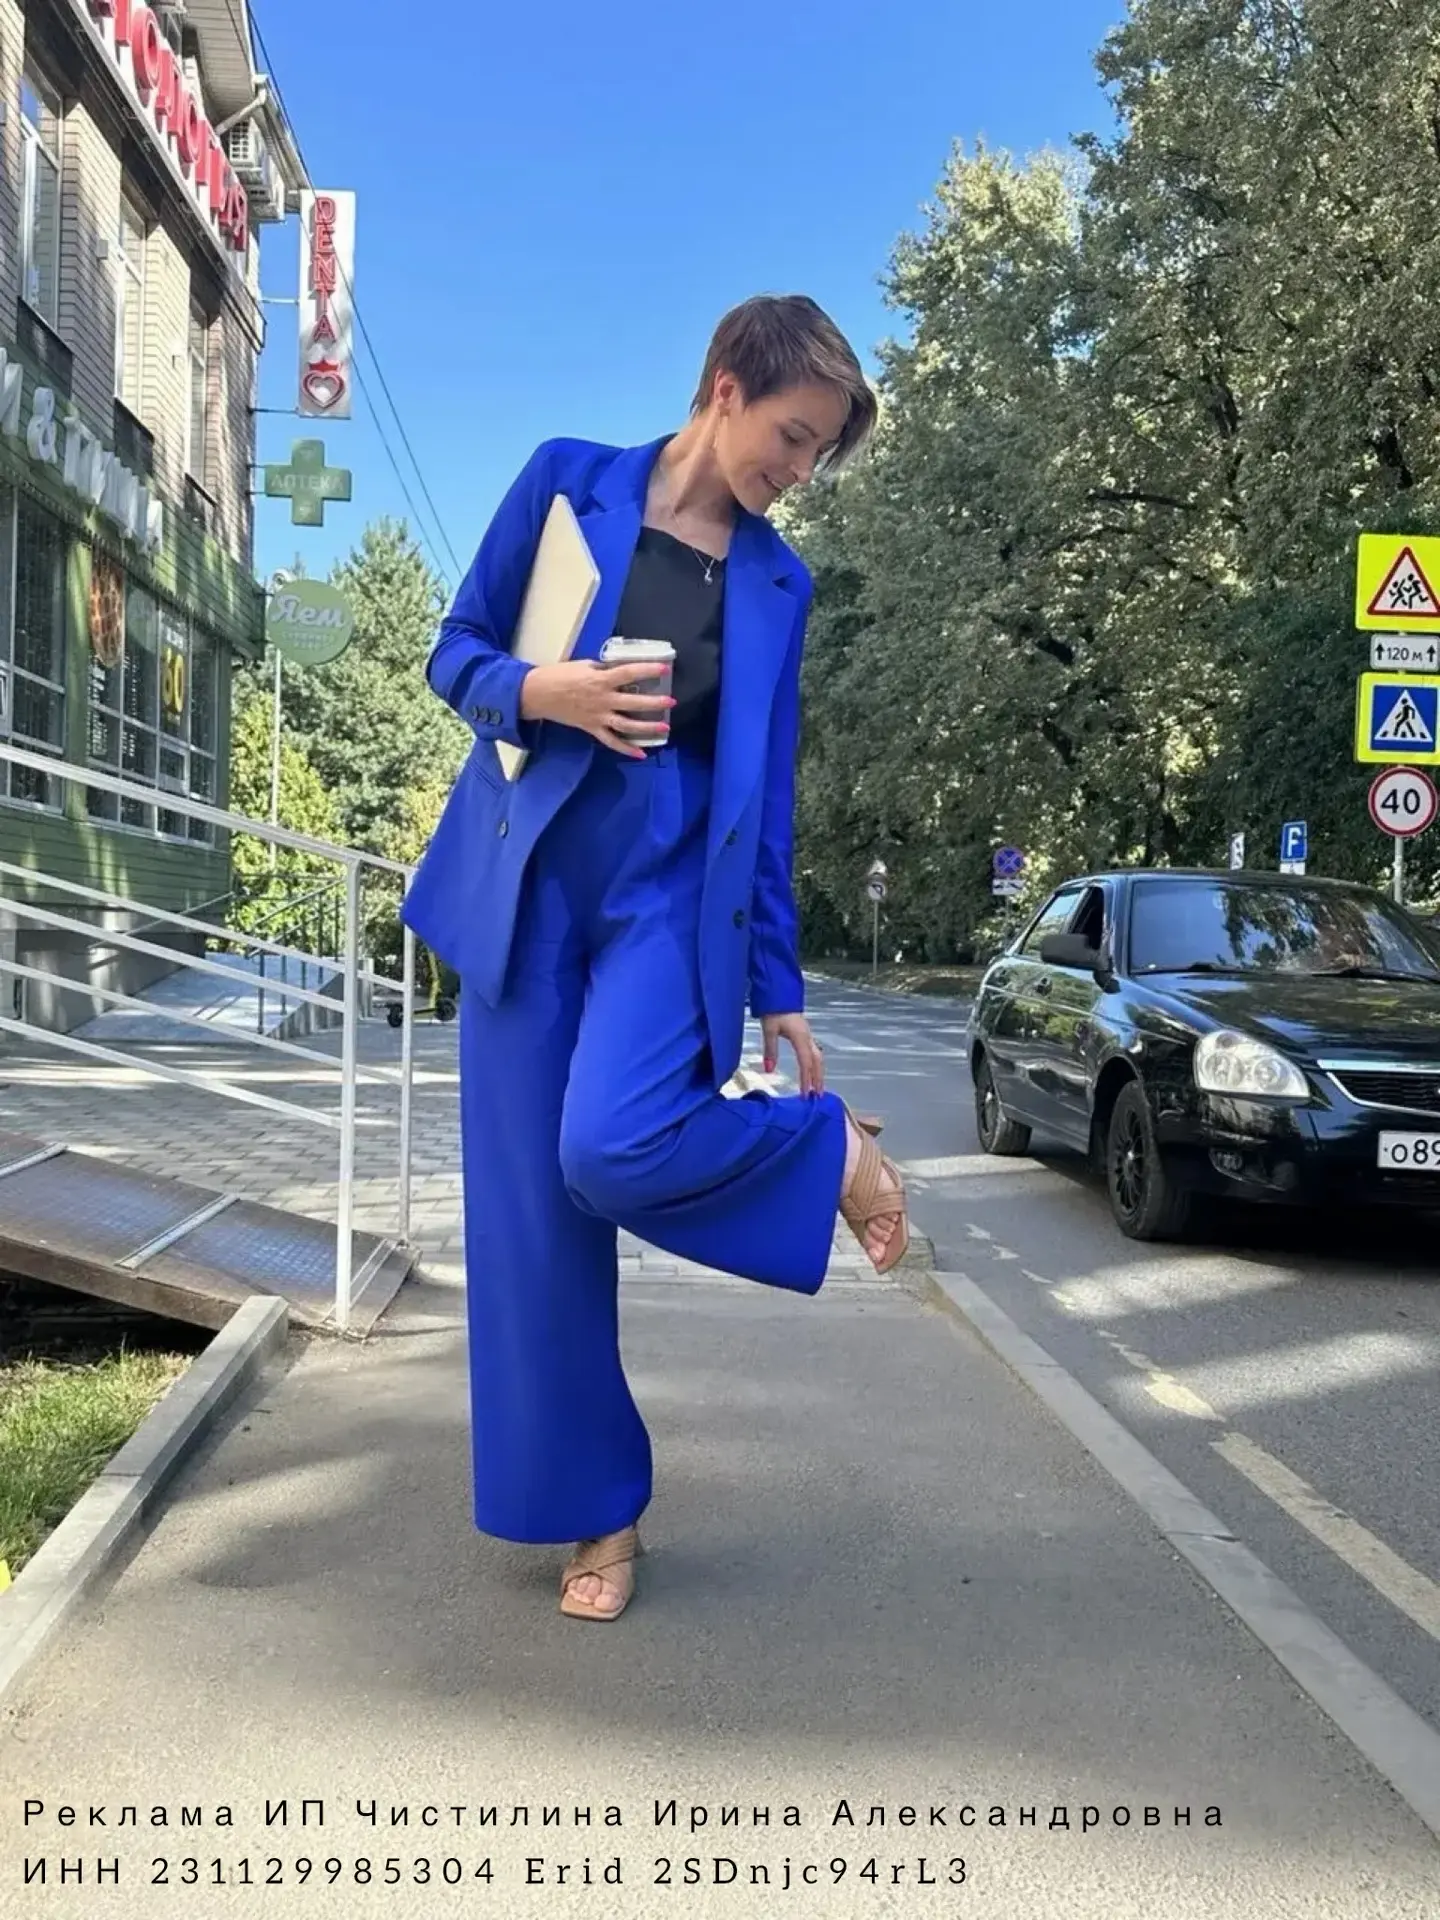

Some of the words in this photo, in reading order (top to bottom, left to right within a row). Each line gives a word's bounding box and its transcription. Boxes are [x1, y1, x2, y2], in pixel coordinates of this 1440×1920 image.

[312, 197, 337, 343] DENTA
[1387, 647, 1410, 661] 120
[1380, 788, 1420, 815] 40
